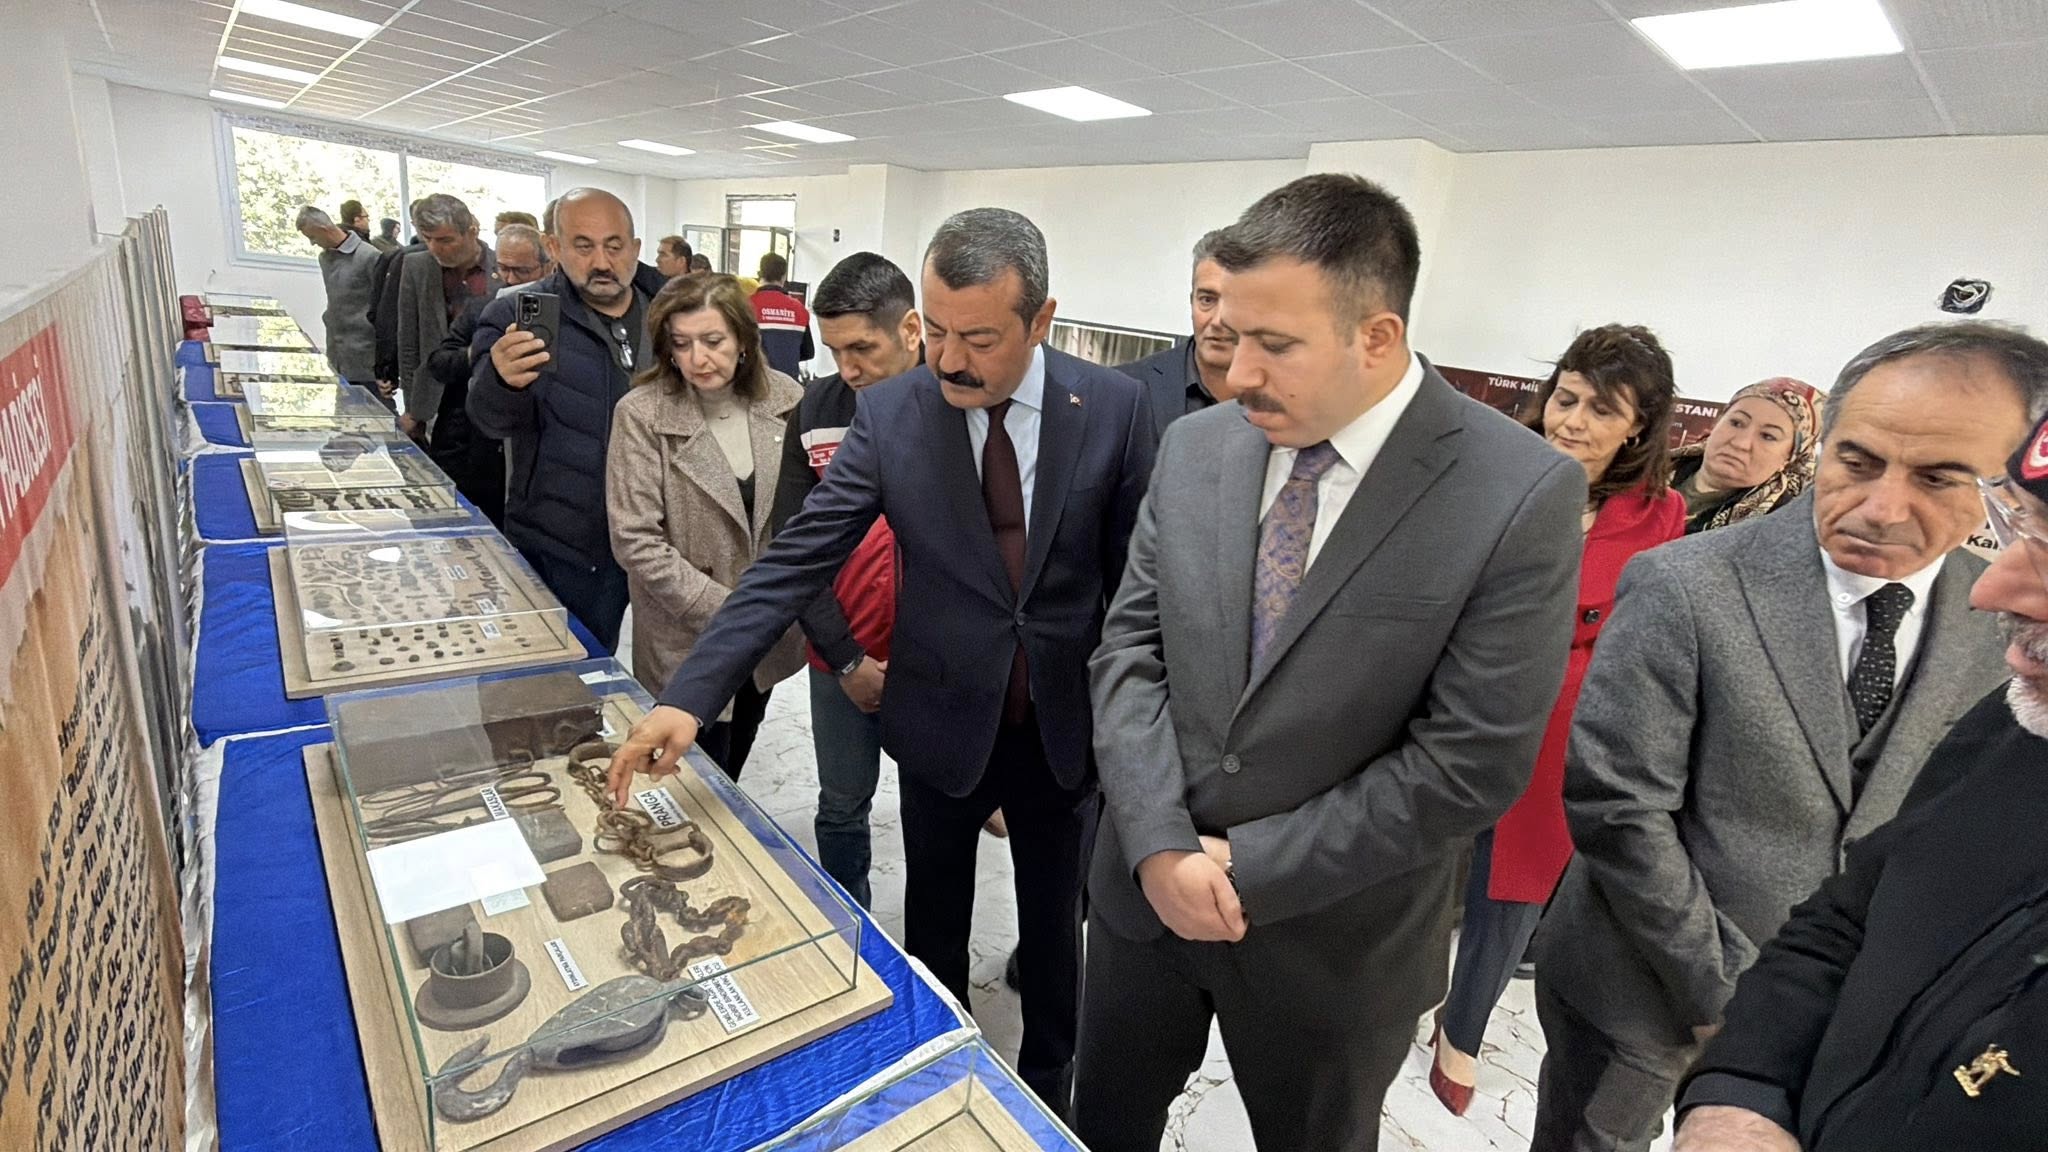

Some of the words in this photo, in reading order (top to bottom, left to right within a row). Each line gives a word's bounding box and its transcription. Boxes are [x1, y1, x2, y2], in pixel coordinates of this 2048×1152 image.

[1488, 376, 1518, 390] TÜRK
[1520, 380, 1539, 393] MİL
[1675, 403, 1719, 418] STANI
[640, 791, 677, 827] PRANGA
